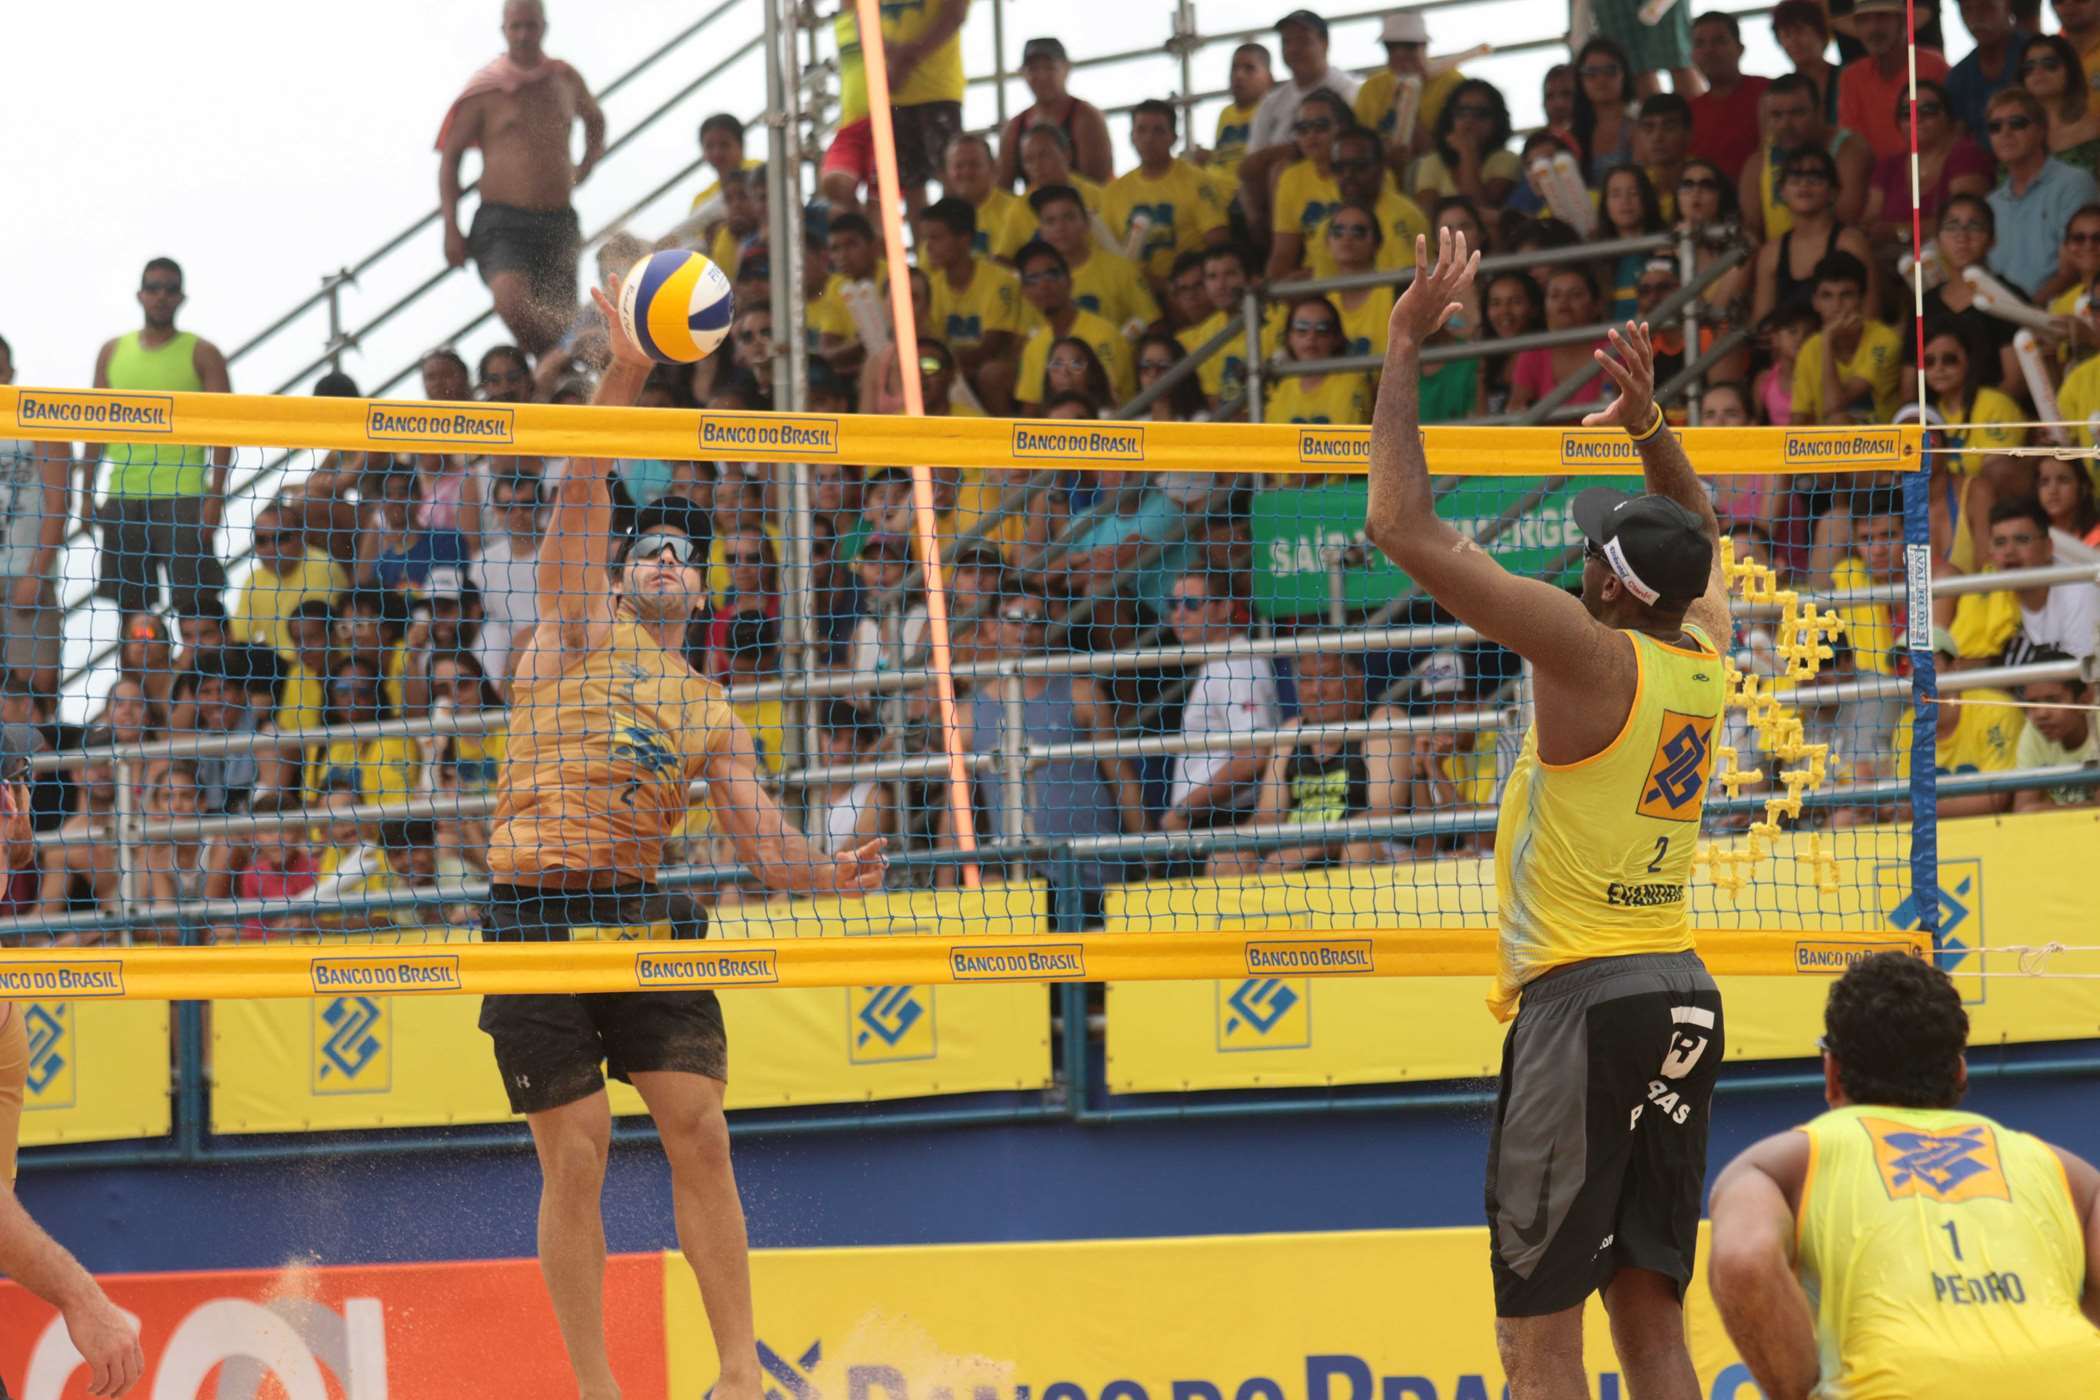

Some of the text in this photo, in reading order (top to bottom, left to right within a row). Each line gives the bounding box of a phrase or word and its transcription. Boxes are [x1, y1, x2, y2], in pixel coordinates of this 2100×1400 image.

[23, 399, 166, 424] BANCO DO BRASIL
[372, 412, 507, 436] BANCO DO BRASIL
[703, 423, 832, 446] BANCO DO BRASIL
[1016, 431, 1138, 453] BANCO DO BRASIL
[1303, 437, 1370, 456] BANCO DO
[1565, 440, 1611, 457] BANCO
[1613, 443, 1630, 457] DO
[1788, 437, 1895, 456] BANCO DO BRASIL
[1647, 836, 1669, 873] 2
[955, 953, 1079, 972] BANCO DO BRASIL
[1250, 948, 1368, 966] BANCO DO BRASIL
[1799, 948, 1842, 966] BANCO
[316, 964, 454, 985] BANCO DO BRASIL
[641, 958, 771, 978] BANCO DO BRASIL
[33, 971, 57, 989] DO
[59, 969, 118, 988] BRASIL
[1941, 1220, 1964, 1261] 1
[1931, 1271, 2026, 1305] PEDRO
